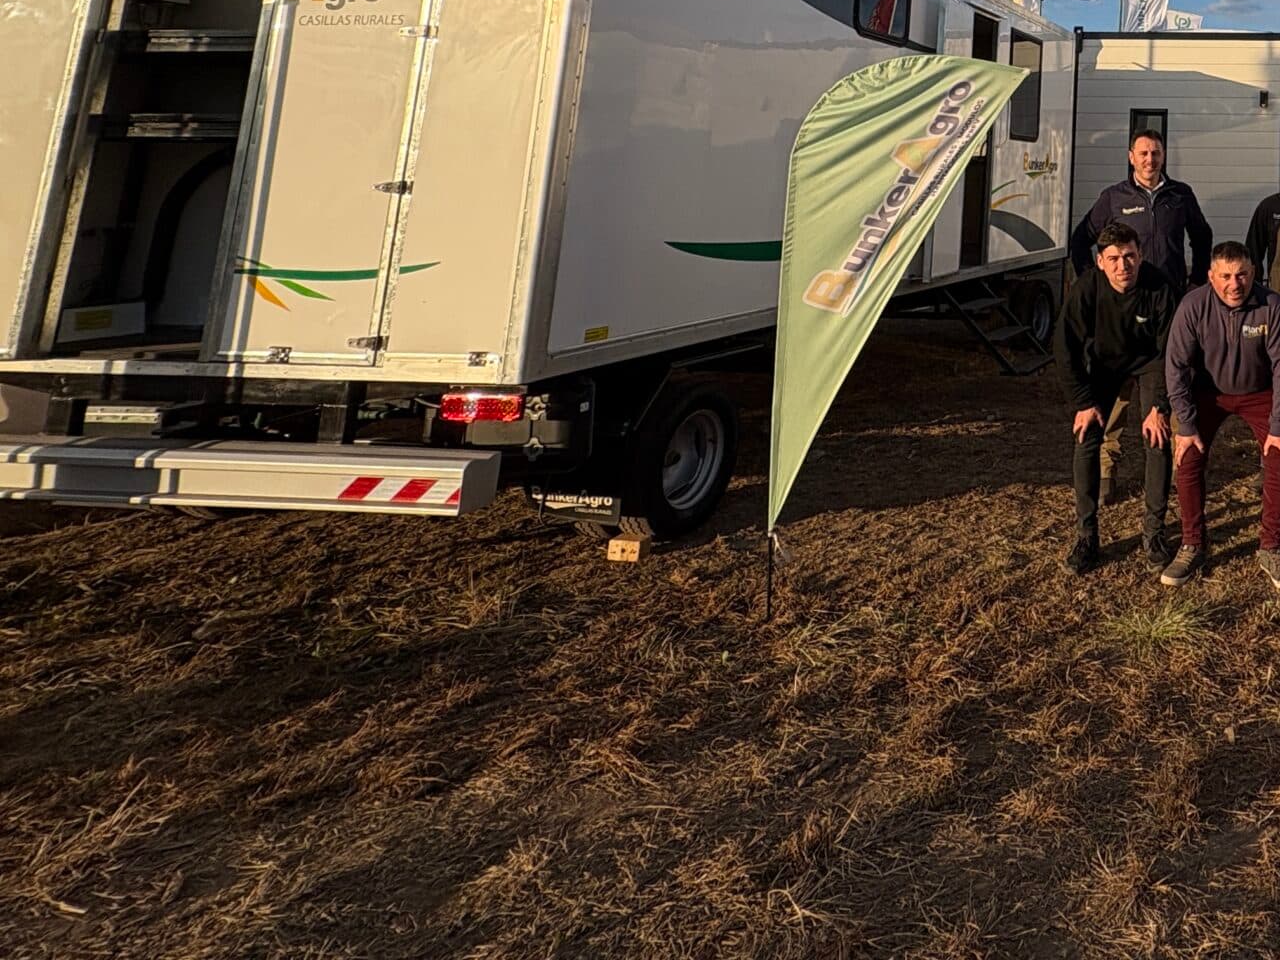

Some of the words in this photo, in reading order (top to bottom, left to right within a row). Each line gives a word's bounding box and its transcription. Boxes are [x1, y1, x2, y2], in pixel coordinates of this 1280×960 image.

[299, 15, 351, 26] CASILLAS
[354, 15, 405, 25] RURALES
[805, 81, 971, 310] BunkerAgro
